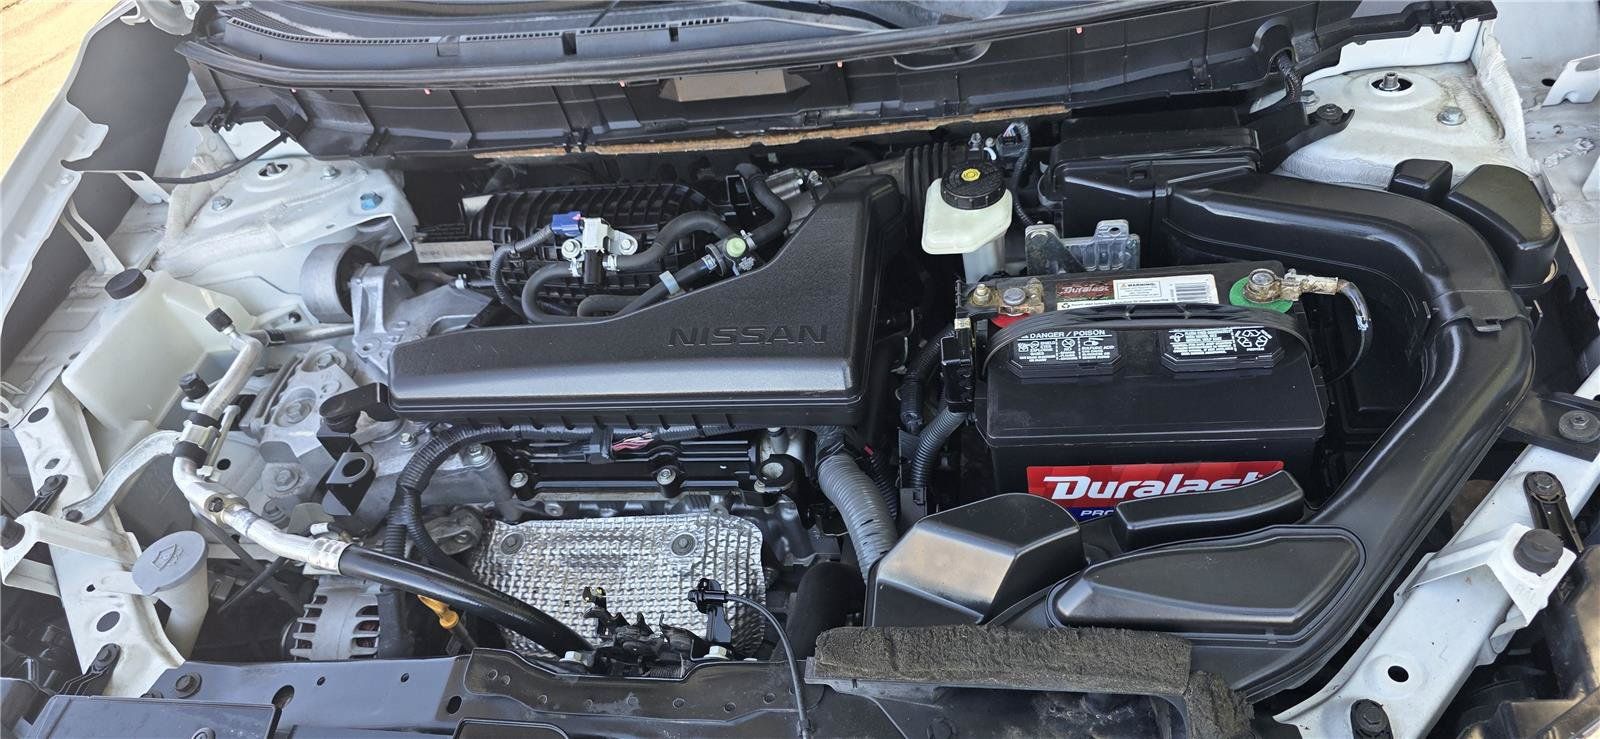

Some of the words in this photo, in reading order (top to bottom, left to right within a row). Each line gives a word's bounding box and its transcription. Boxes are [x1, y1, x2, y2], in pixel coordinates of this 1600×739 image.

[1059, 283, 1109, 294] Duralast
[668, 325, 828, 347] NISSAN
[1030, 331, 1065, 339] DANGER
[1073, 329, 1106, 337] POISON
